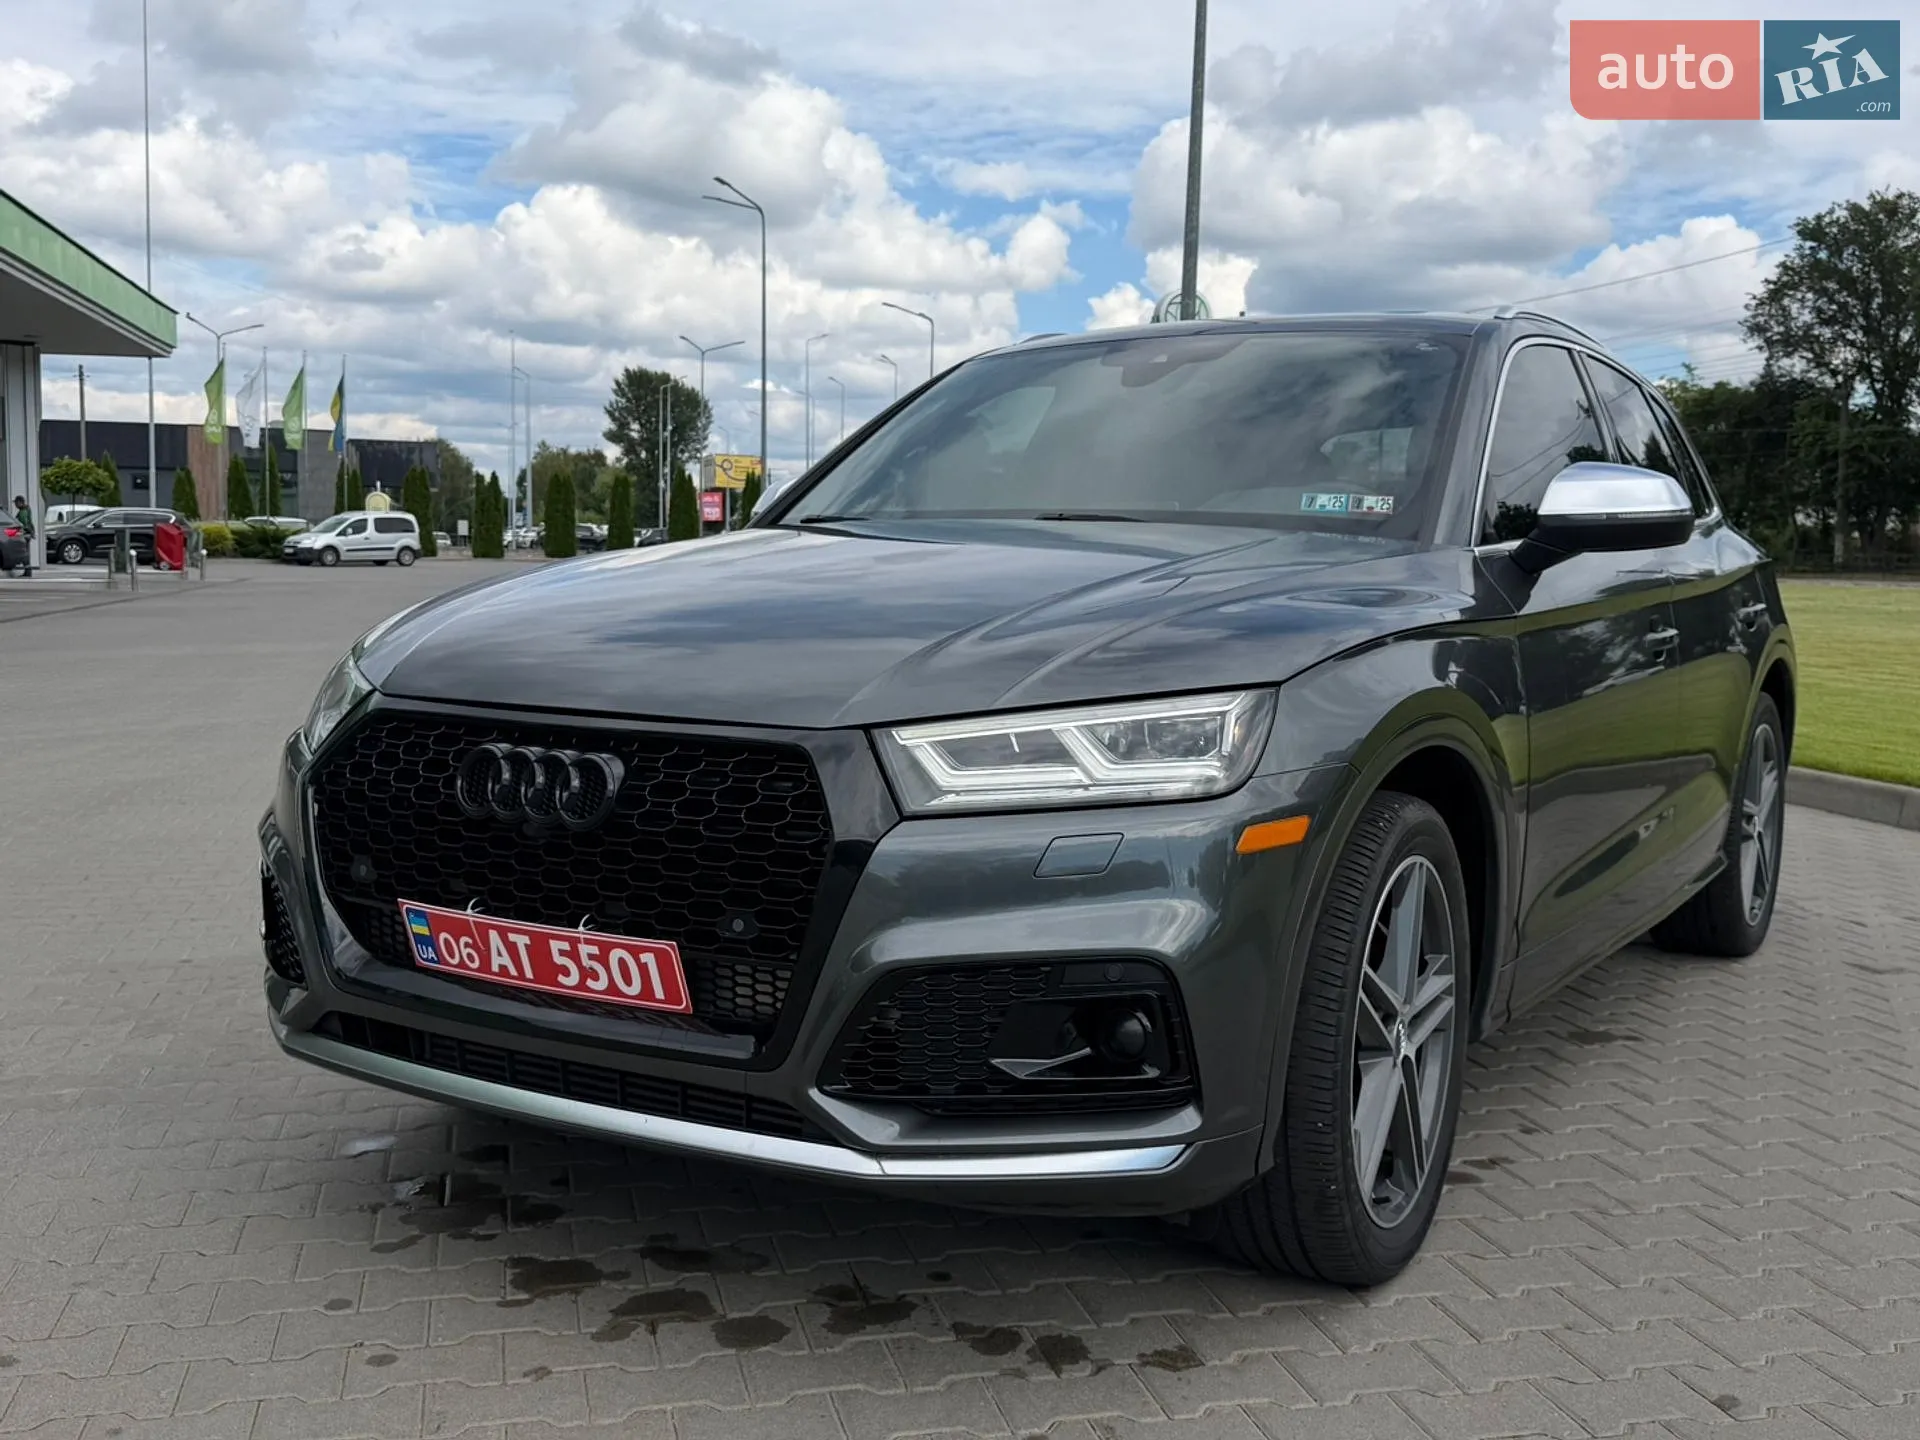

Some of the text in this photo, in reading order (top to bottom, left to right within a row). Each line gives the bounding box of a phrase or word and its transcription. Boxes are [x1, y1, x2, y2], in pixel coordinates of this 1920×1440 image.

[417, 929, 666, 1001] UA 06 AT 5501
